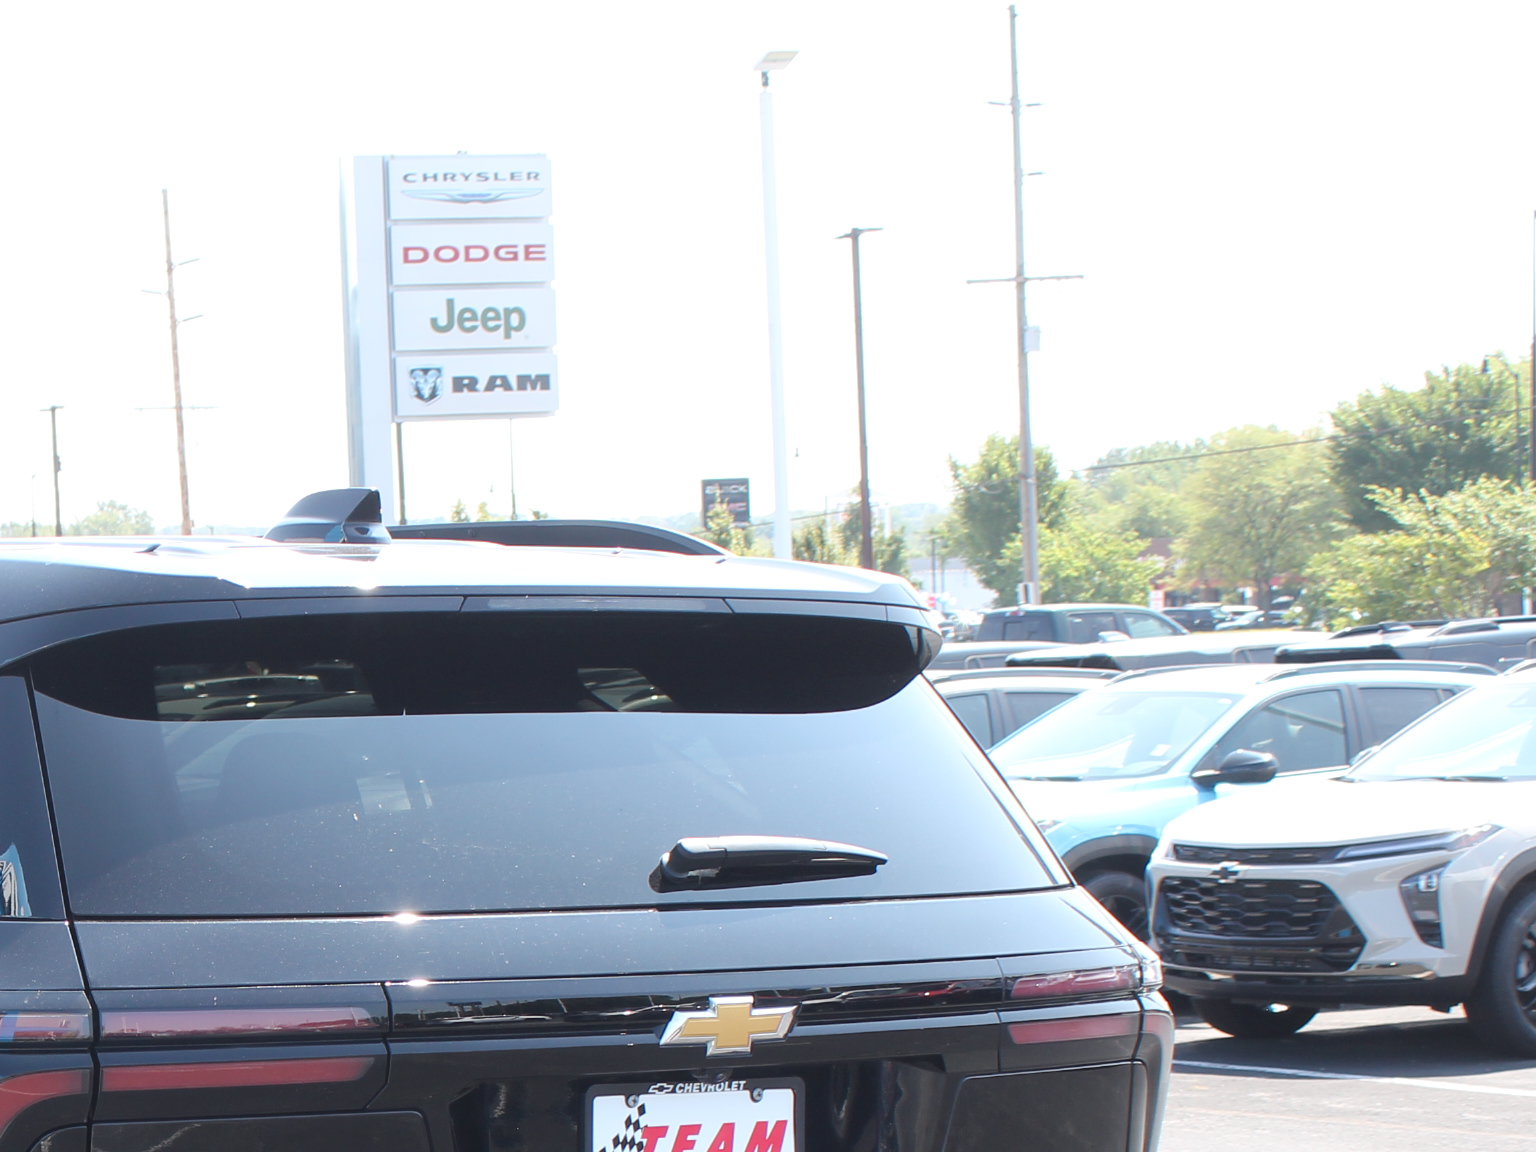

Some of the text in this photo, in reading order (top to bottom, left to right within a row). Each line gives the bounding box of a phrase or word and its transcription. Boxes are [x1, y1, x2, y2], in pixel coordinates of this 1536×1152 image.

[402, 171, 541, 183] CHRYSLER
[402, 244, 547, 264] DODGE
[430, 298, 527, 339] Jeep
[451, 374, 551, 393] RAM
[675, 1080, 747, 1094] CHEVROLET
